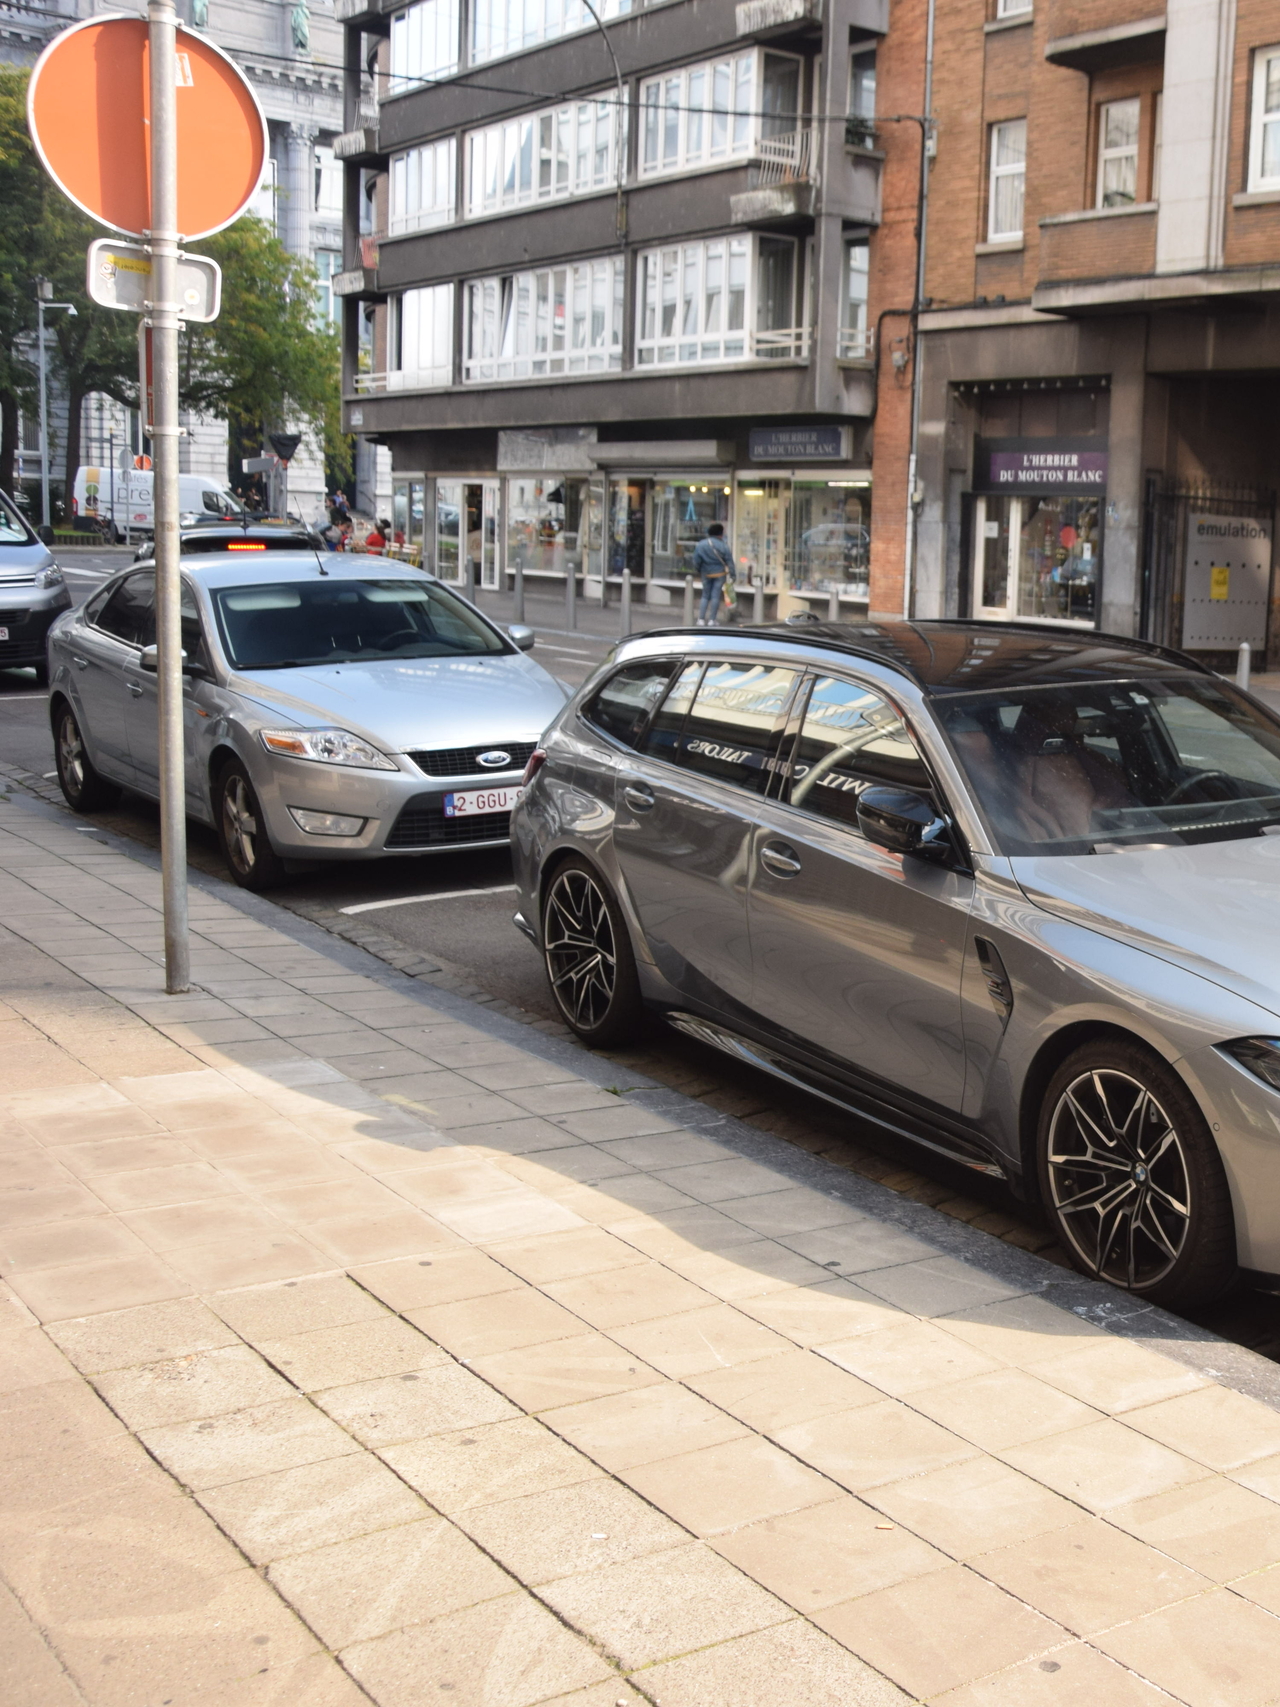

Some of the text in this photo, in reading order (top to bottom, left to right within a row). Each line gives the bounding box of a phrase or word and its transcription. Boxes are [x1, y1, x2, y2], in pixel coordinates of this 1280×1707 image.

[771, 432, 818, 444] L'HERBIER
[754, 442, 837, 456] DU MOUTON BLANC
[1023, 453, 1079, 467] L'HERBIER
[1000, 469, 1104, 483] DU MOUTON BLANC
[117, 486, 154, 503] pre
